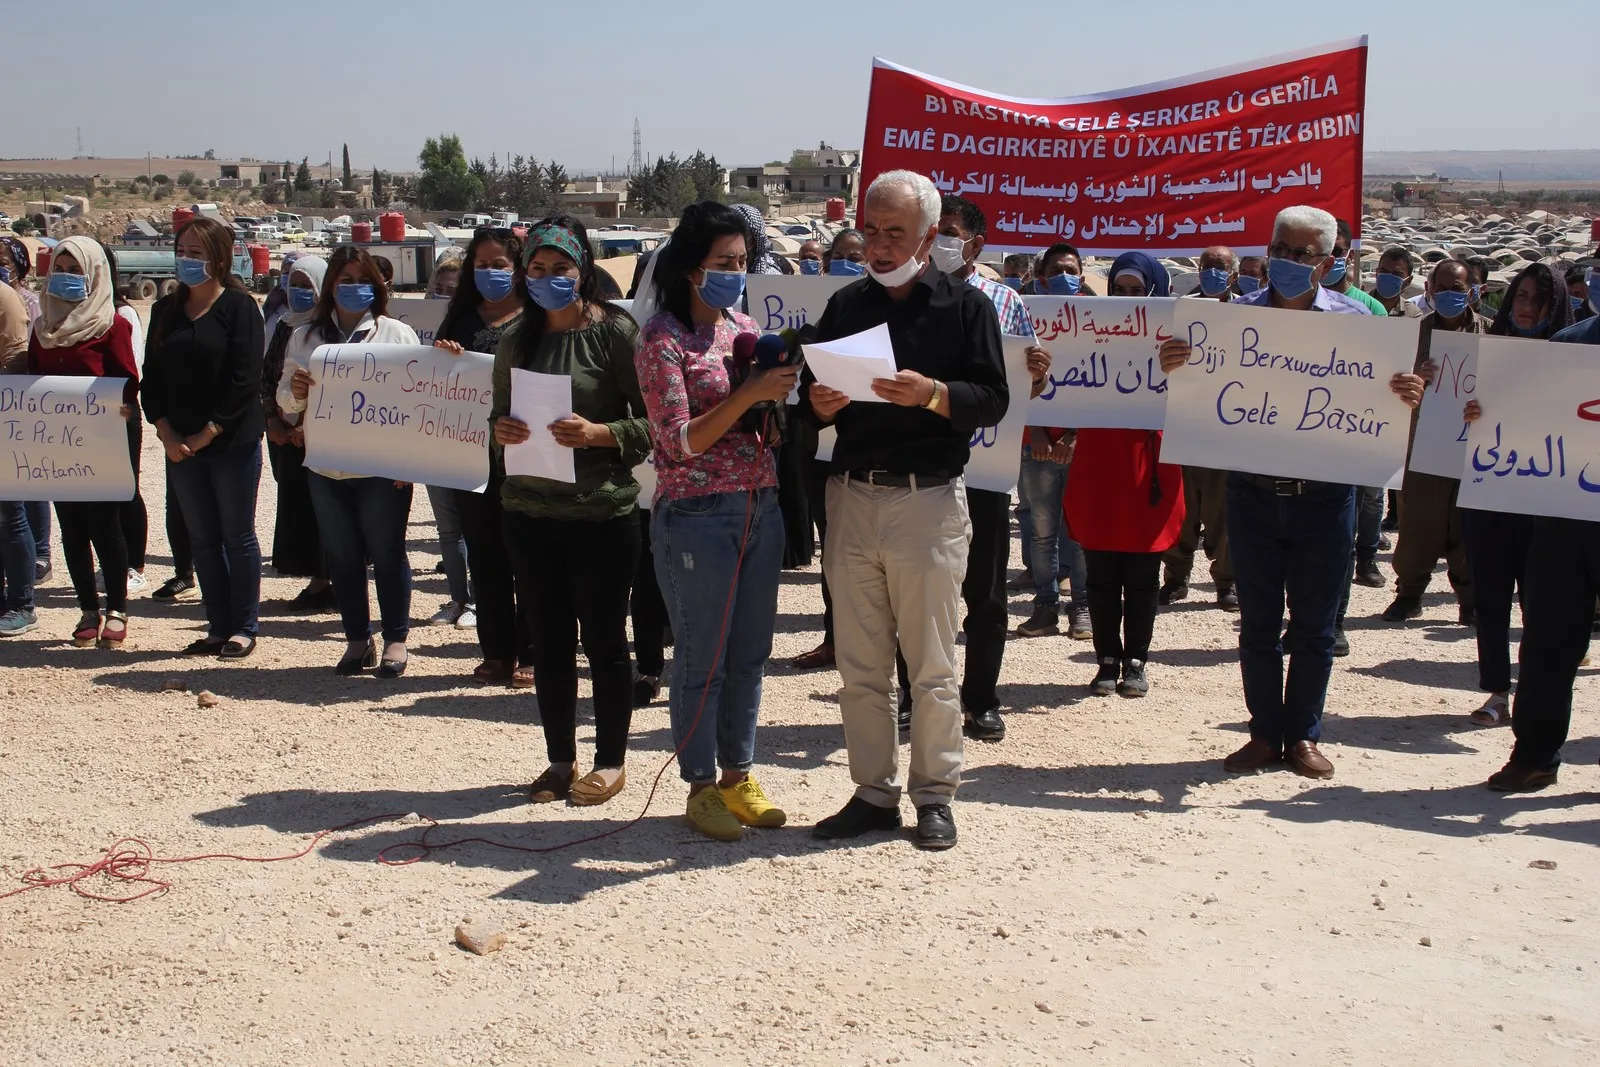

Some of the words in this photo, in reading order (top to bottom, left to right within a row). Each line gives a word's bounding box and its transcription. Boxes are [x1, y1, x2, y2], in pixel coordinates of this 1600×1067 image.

[925, 94, 947, 114] BI
[952, 98, 1051, 129] RASTIYA
[1057, 112, 1121, 133] GELÊ
[1126, 99, 1221, 133] ŞERKER
[1226, 90, 1244, 114] Û
[1250, 74, 1339, 107] GERÎLA
[883, 127, 936, 151] EMÊ
[941, 132, 1107, 159] DAGIRKERIYÊ
[1113, 134, 1131, 158] Û
[1137, 126, 1242, 157] ÎXANETÊ
[1247, 122, 1293, 148] TÊK
[1297, 112, 1360, 143] BIBIN
[999, 173, 1078, 203] وببسالة
[1083, 174, 1156, 204] الثورية
[1161, 168, 1246, 200] الشعبية
[1251, 162, 1322, 194] بالحرب
[995, 210, 1076, 240] والخيانة
[1080, 212, 1164, 242] الإحتلال
[1166, 212, 1246, 239] سندحر
[1082, 304, 1147, 343] الشعبية
[322, 347, 354, 379] Her
[361, 352, 391, 384] Der
[1187, 321, 1226, 373] Bijî
[1239, 327, 1375, 380] Berxwedana
[1116, 357, 1168, 395] مان
[0, 387, 23, 413] Dil
[27, 397, 37, 414] û
[85, 392, 106, 415] Bi
[315, 384, 333, 420] Li
[350, 390, 410, 427] Başûr
[414, 403, 487, 448] Tolhildan
[1216, 381, 1278, 426] Gelê
[1295, 387, 1390, 438] Başûr
[61, 424, 84, 447] Ne
[12, 450, 96, 481] Haftanîn
[1472, 421, 1566, 483] الدولي
